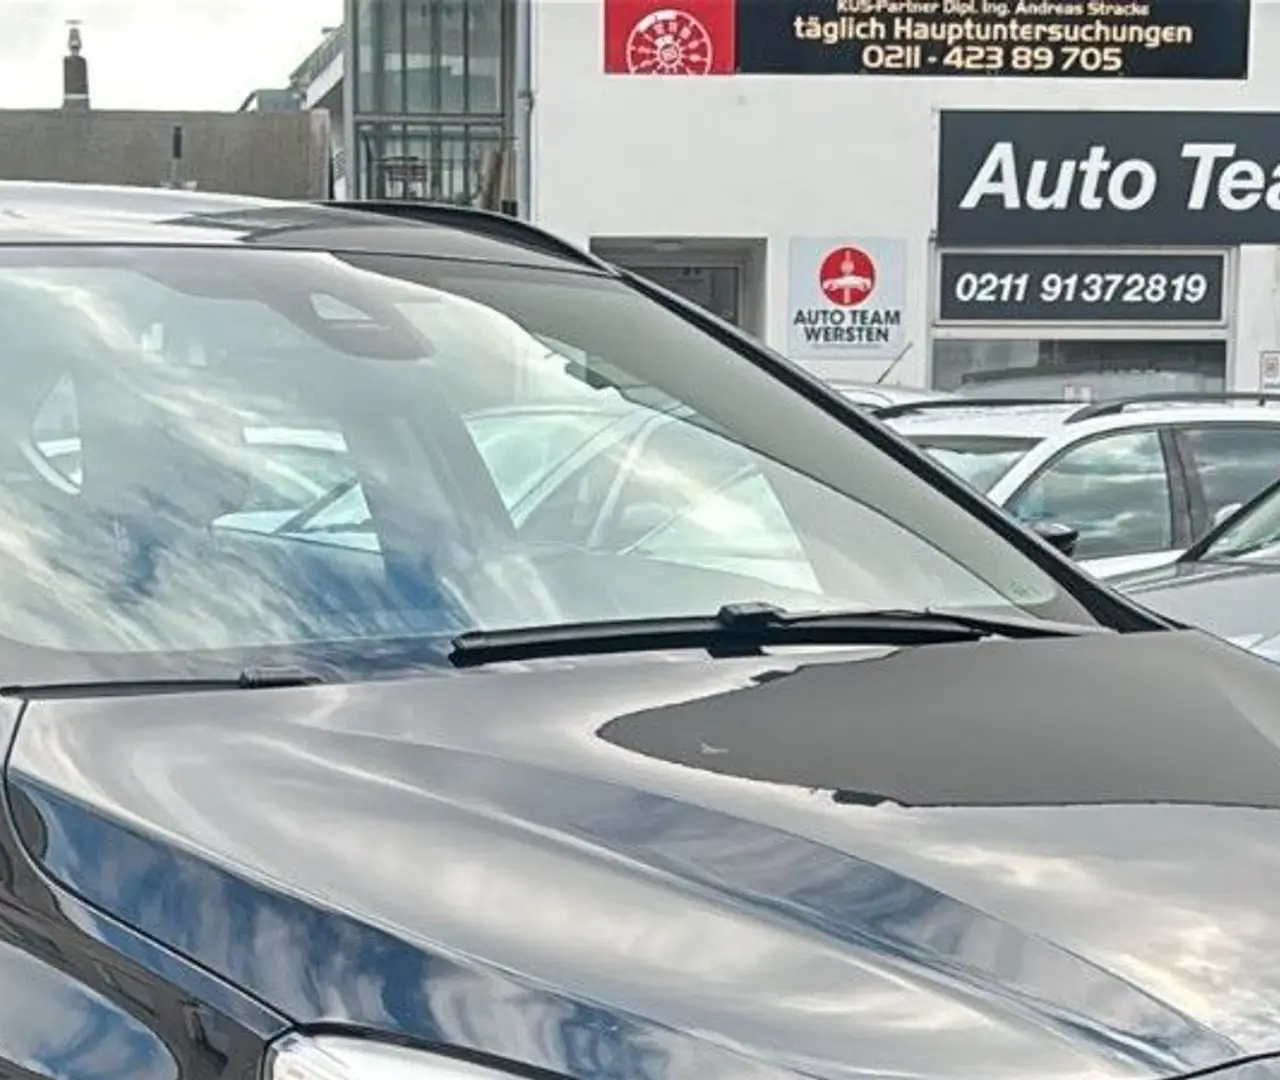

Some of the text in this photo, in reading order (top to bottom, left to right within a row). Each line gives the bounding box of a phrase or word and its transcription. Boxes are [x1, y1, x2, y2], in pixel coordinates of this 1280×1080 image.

[1014, 1, 1084, 16] Andreas
[793, 15, 1193, 48] täglich Hauptuntersuchungen
[861, 44, 921, 69] 0211
[942, 45, 1004, 70] 423
[1010, 46, 1055, 71] 89
[1060, 47, 1123, 71] 705
[959, 141, 1158, 212] Auto
[954, 271, 1208, 304] 0211 91372819
[793, 308, 901, 326] AUTO TEAM
[803, 326, 890, 343] WERSTEN
